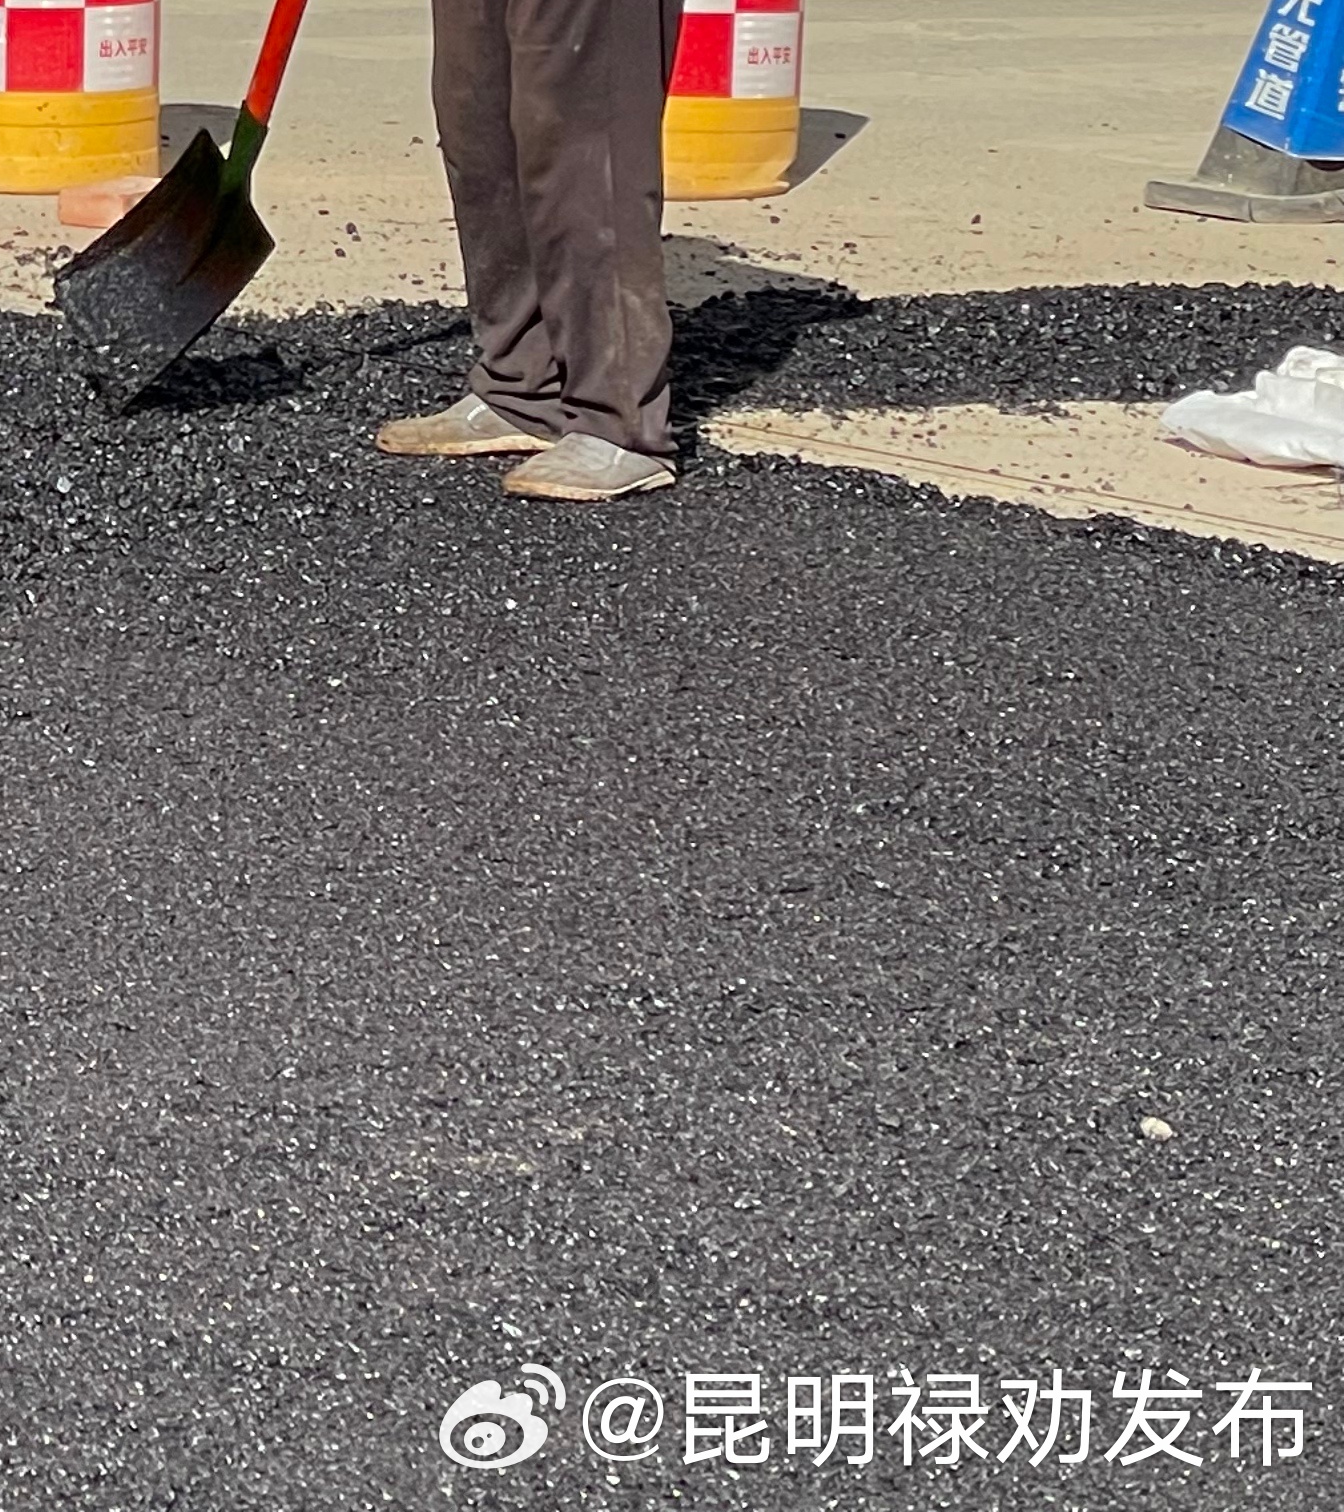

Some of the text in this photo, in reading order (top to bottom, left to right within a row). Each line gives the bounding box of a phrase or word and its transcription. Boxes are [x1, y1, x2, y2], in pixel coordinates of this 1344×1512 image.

[99, 38, 149, 59] 出入平安
[748, 46, 791, 65] 出入平安
